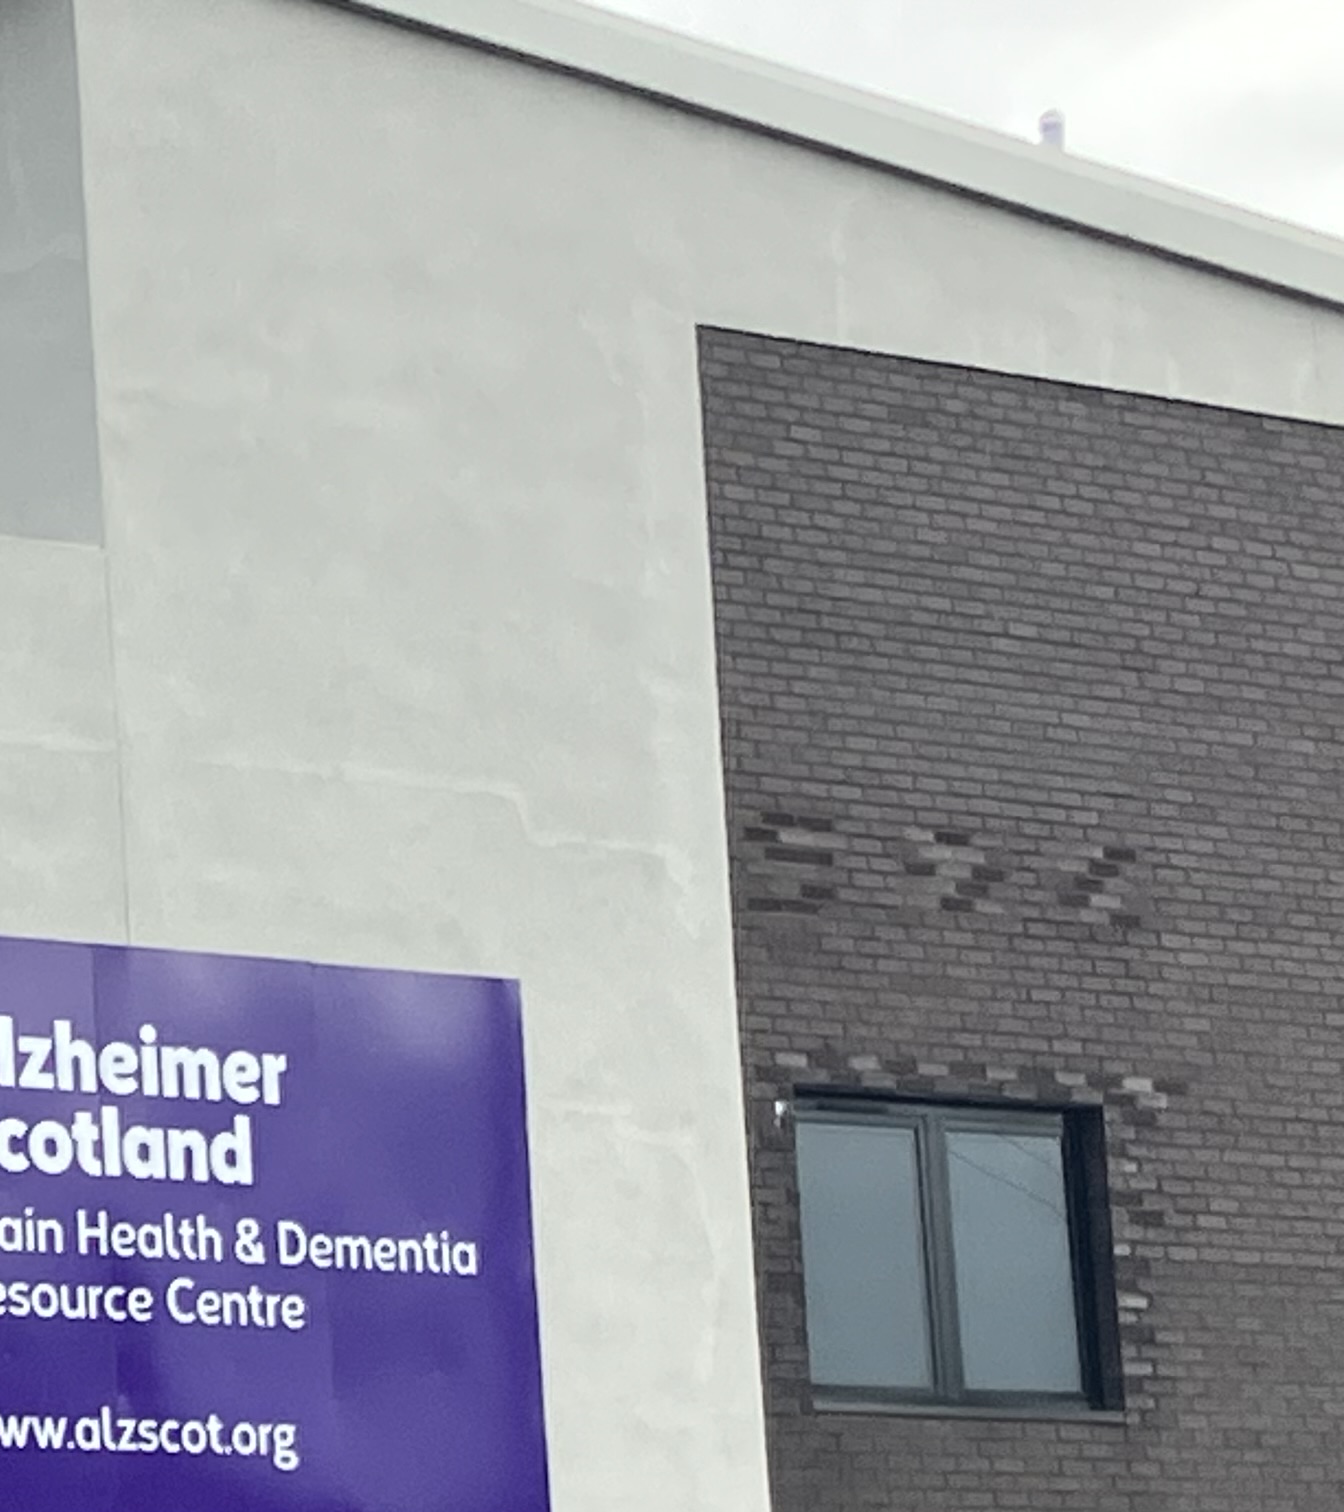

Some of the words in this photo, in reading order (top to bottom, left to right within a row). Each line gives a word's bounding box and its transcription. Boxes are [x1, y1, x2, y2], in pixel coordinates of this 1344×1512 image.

[76, 1207, 224, 1264] Health
[234, 1217, 267, 1265] &
[277, 1220, 479, 1277] Dementia
[165, 1276, 307, 1330] Centre
